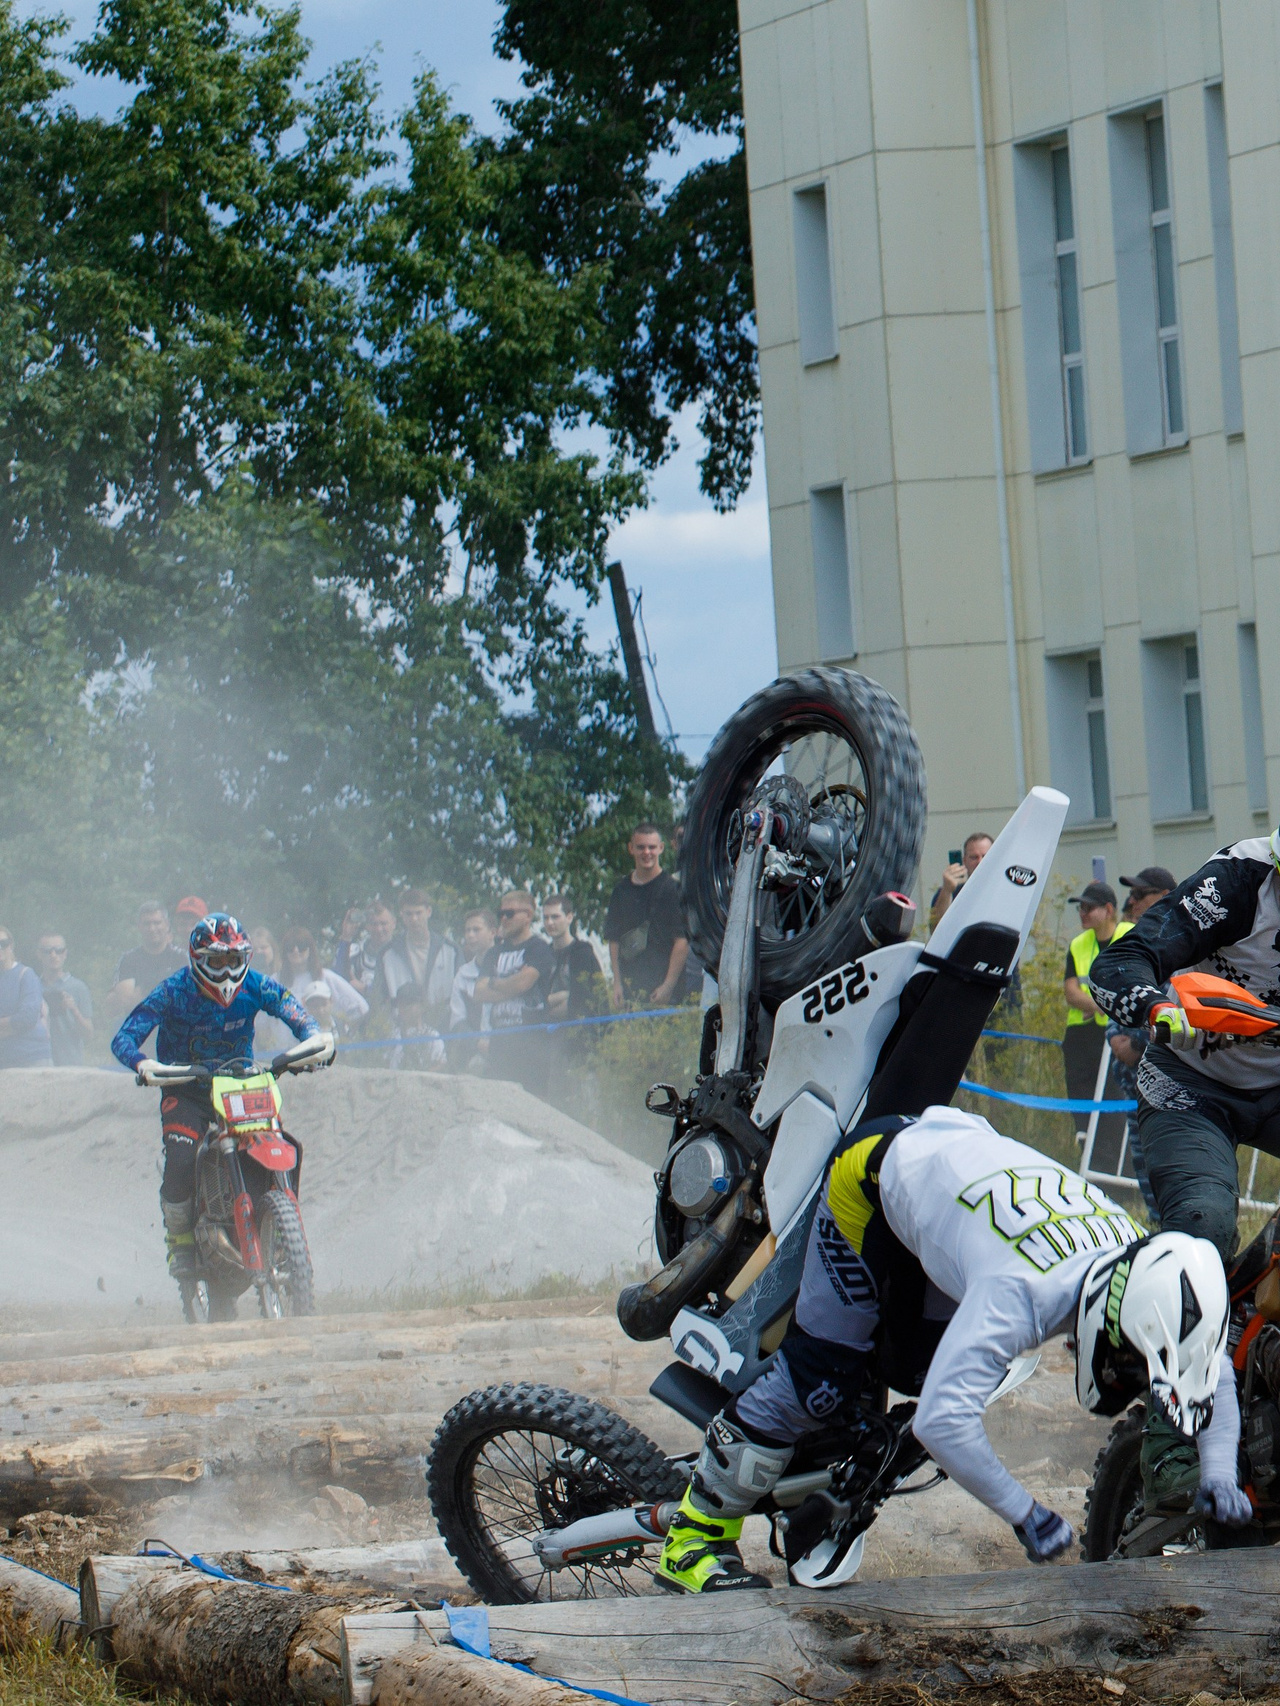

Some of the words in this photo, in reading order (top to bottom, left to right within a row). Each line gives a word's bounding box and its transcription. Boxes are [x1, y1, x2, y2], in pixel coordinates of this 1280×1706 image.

[1009, 868, 1035, 885] Airoh
[1189, 898, 1217, 923] ENDURO
[1191, 907, 1209, 925] URAL
[802, 961, 869, 1024] 222
[816, 1242, 839, 1275] RACE
[828, 1272, 853, 1307] GEAR
[818, 1217, 878, 1301] SHOT
[1105, 1259, 1131, 1350] 100%
